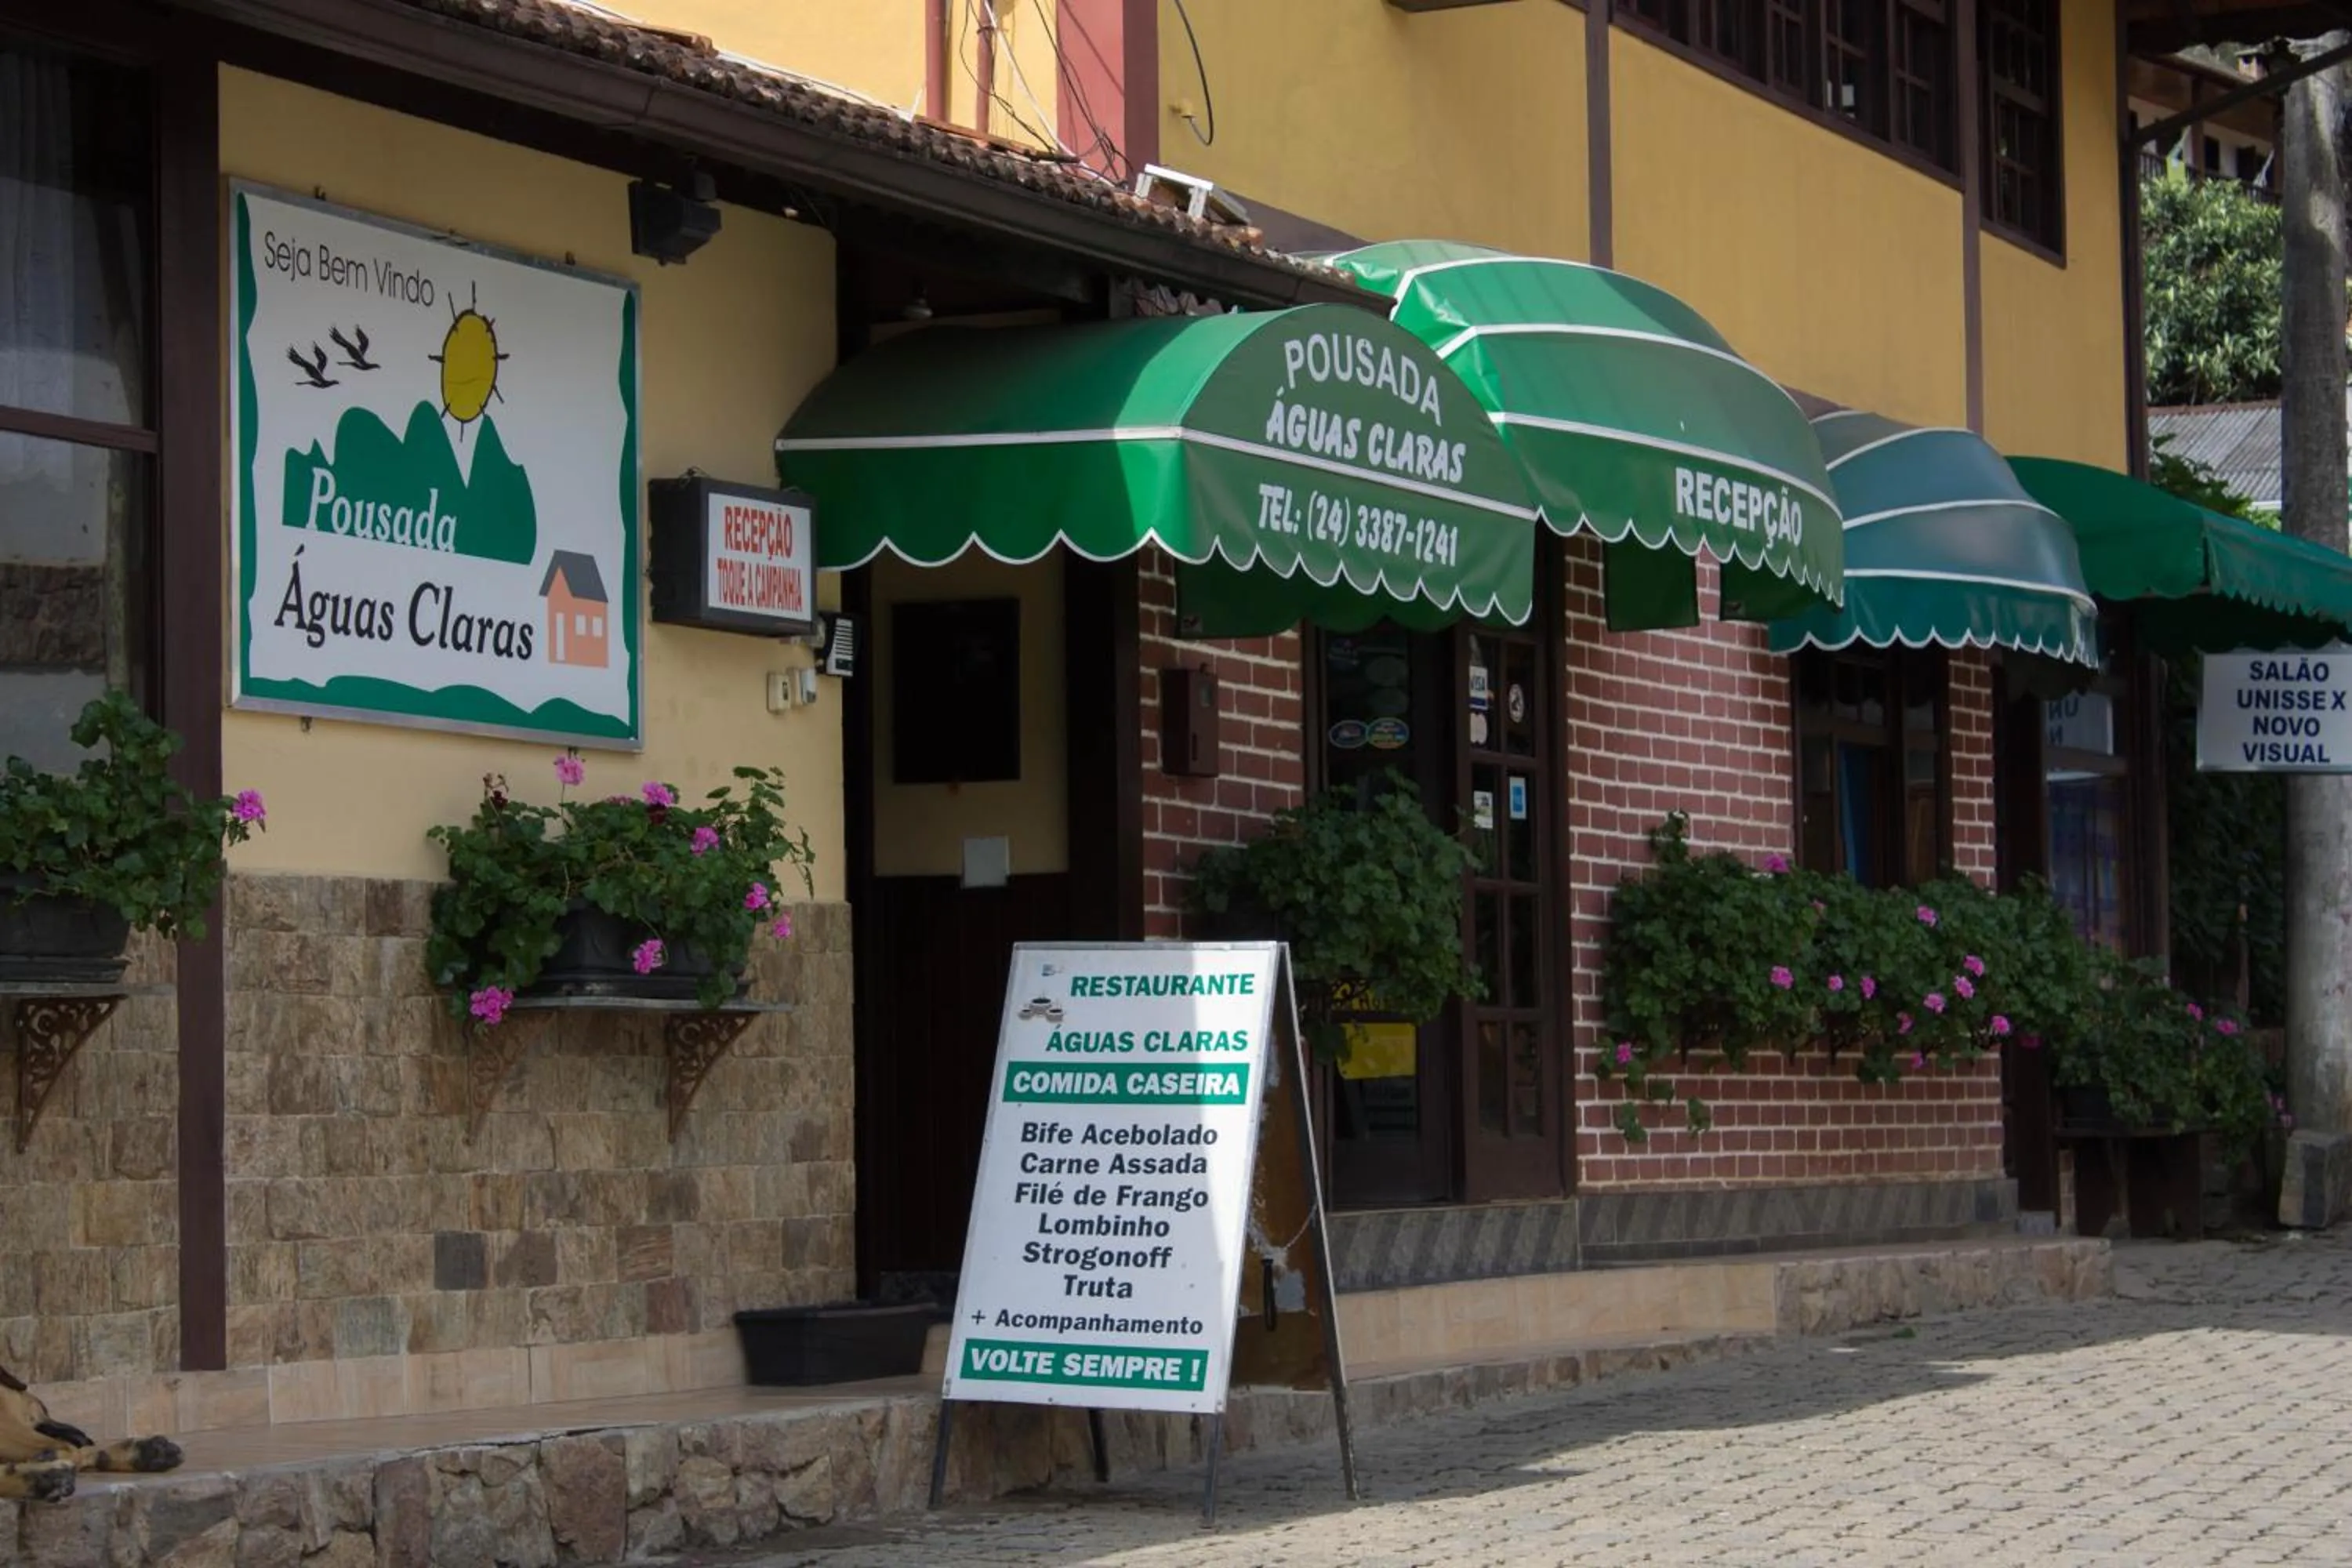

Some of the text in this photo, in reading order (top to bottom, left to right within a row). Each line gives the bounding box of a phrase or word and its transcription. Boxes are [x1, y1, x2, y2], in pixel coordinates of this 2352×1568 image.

[265, 231, 434, 307] Seja Bem Vindo
[1285, 333, 1442, 426] POUSADA
[1266, 387, 1466, 484] ÁGUAS CLARAS
[305, 467, 458, 553] Pousada
[1675, 466, 1802, 549] RECEPÇÃO
[724, 506, 793, 560] RECEPÇÃO
[1259, 484, 1457, 567] TEL: (24) 3387-1241
[717, 558, 746, 605] TOQUE
[748, 564, 753, 606] A
[274, 543, 534, 661] Águas Claras
[2249, 656, 2329, 683] SALÃO
[2252, 717, 2321, 738] NOVO
[2243, 742, 2331, 764] VISUAL
[1070, 973, 1255, 996] RESTAURANTE
[1046, 1024, 1249, 1053] ÁGUAS CLARAS
[1012, 1071, 1240, 1096] COMIDA CASEIRA
[1021, 1122, 1218, 1146] Bife Acebolado
[1020, 1152, 1207, 1175] Carne Assada
[1014, 1181, 1208, 1213] Filé de Frango
[1038, 1213, 1170, 1237] Lombinho
[1022, 1241, 1173, 1270] Strogonoff
[1063, 1274, 1133, 1299] Truta
[995, 1308, 1203, 1335] Acompanhamento
[971, 1348, 1056, 1374] VOLTE
[1062, 1352, 1182, 1381] SEMPRE
